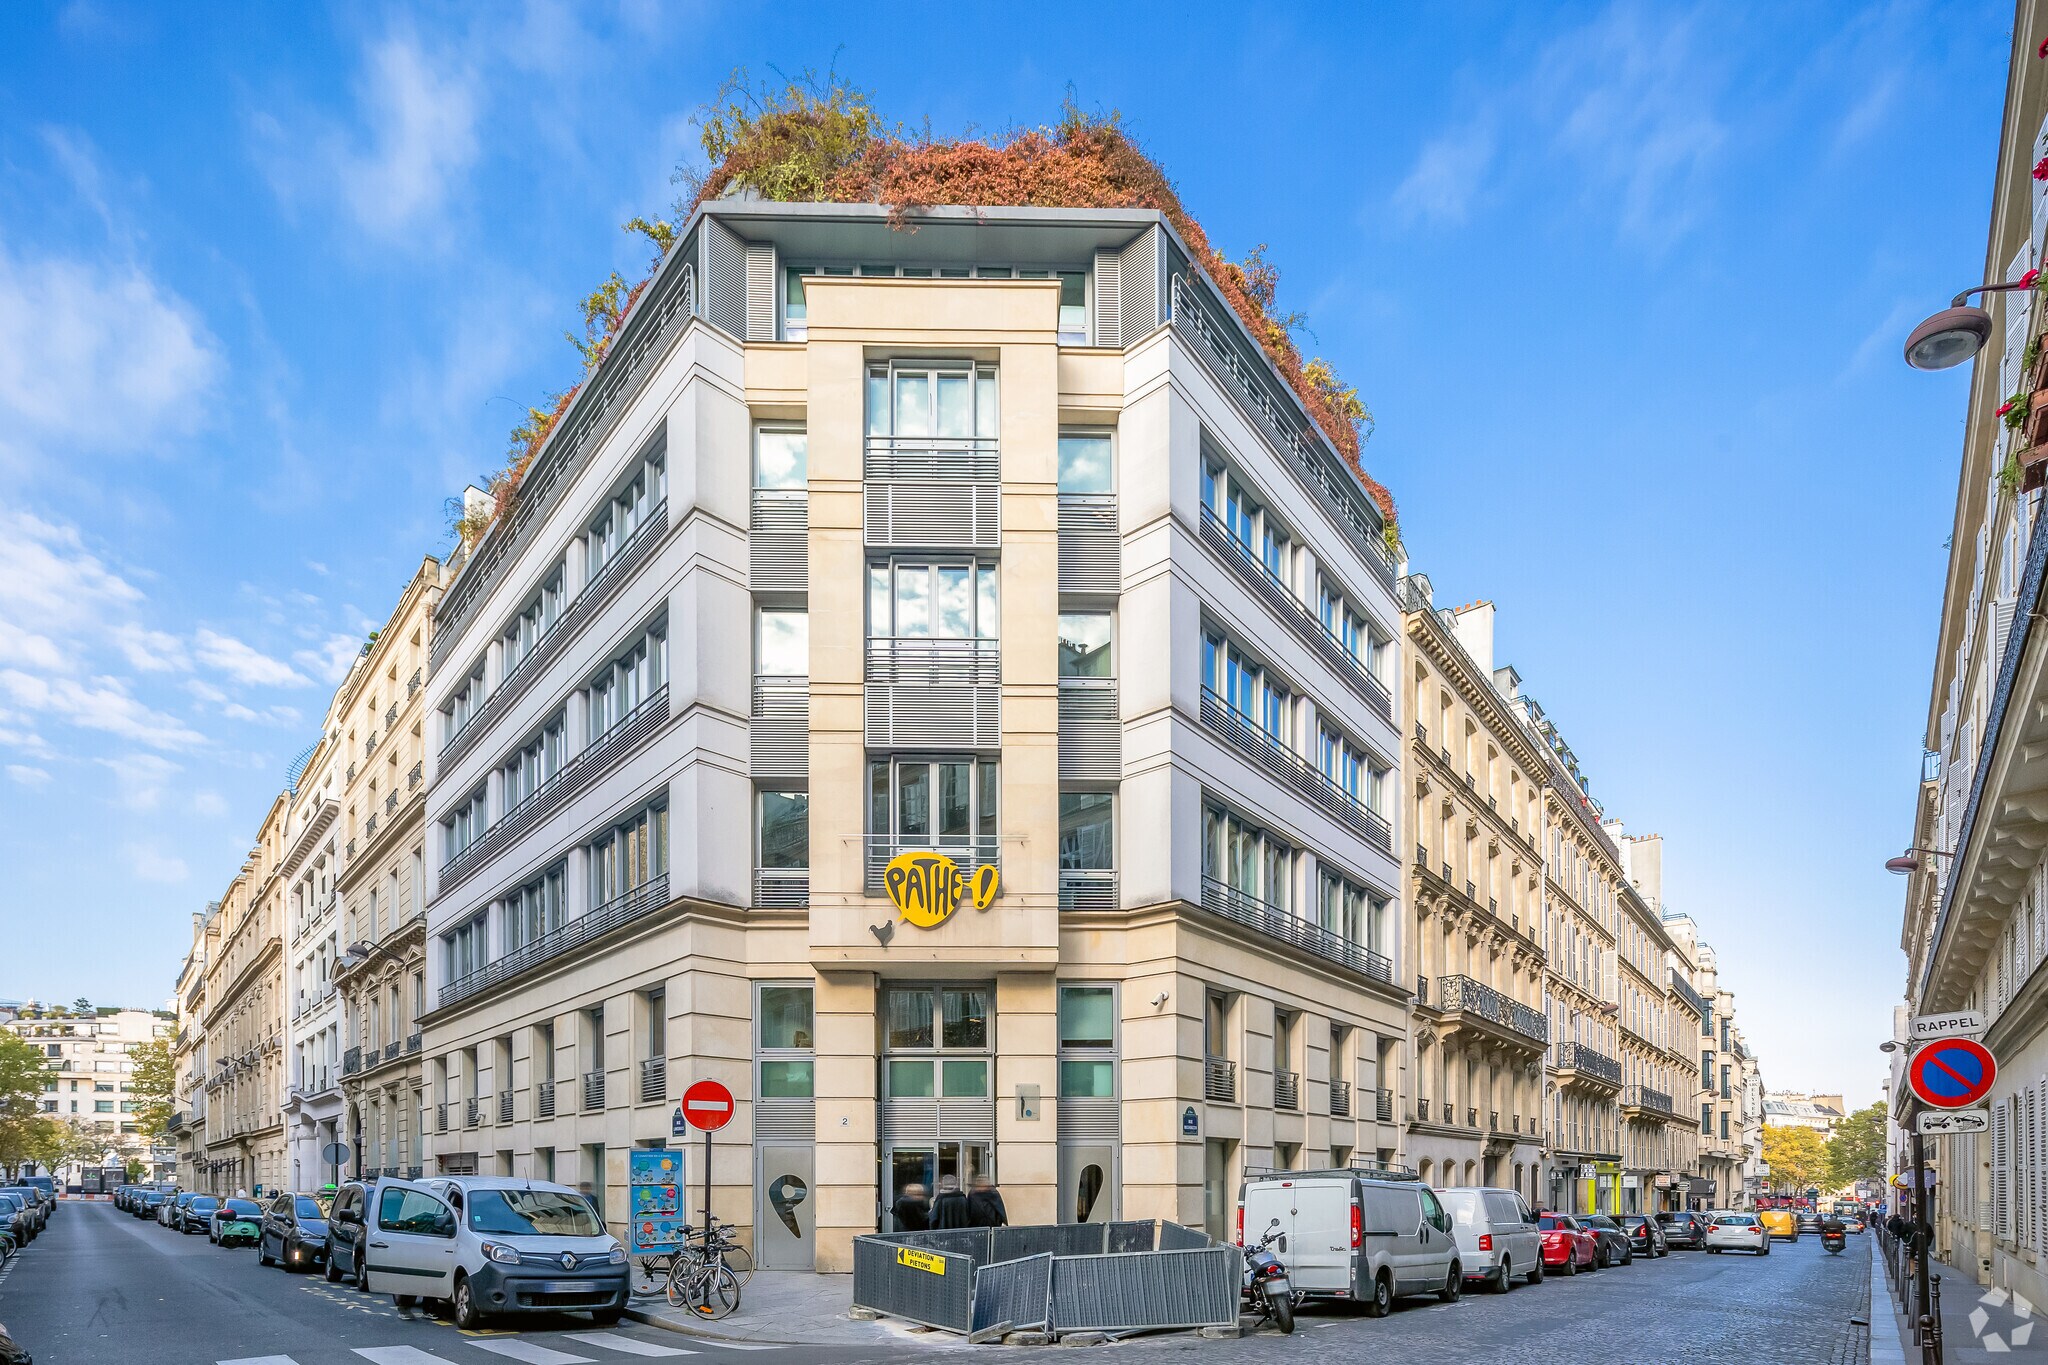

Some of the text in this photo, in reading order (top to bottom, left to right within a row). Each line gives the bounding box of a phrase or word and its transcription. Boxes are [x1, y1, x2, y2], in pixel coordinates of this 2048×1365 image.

[1917, 1018, 1979, 1032] RAPPEL
[842, 1117, 848, 1125] 2
[907, 1249, 935, 1261] DEVIATION
[909, 1259, 931, 1270] PIETONS
